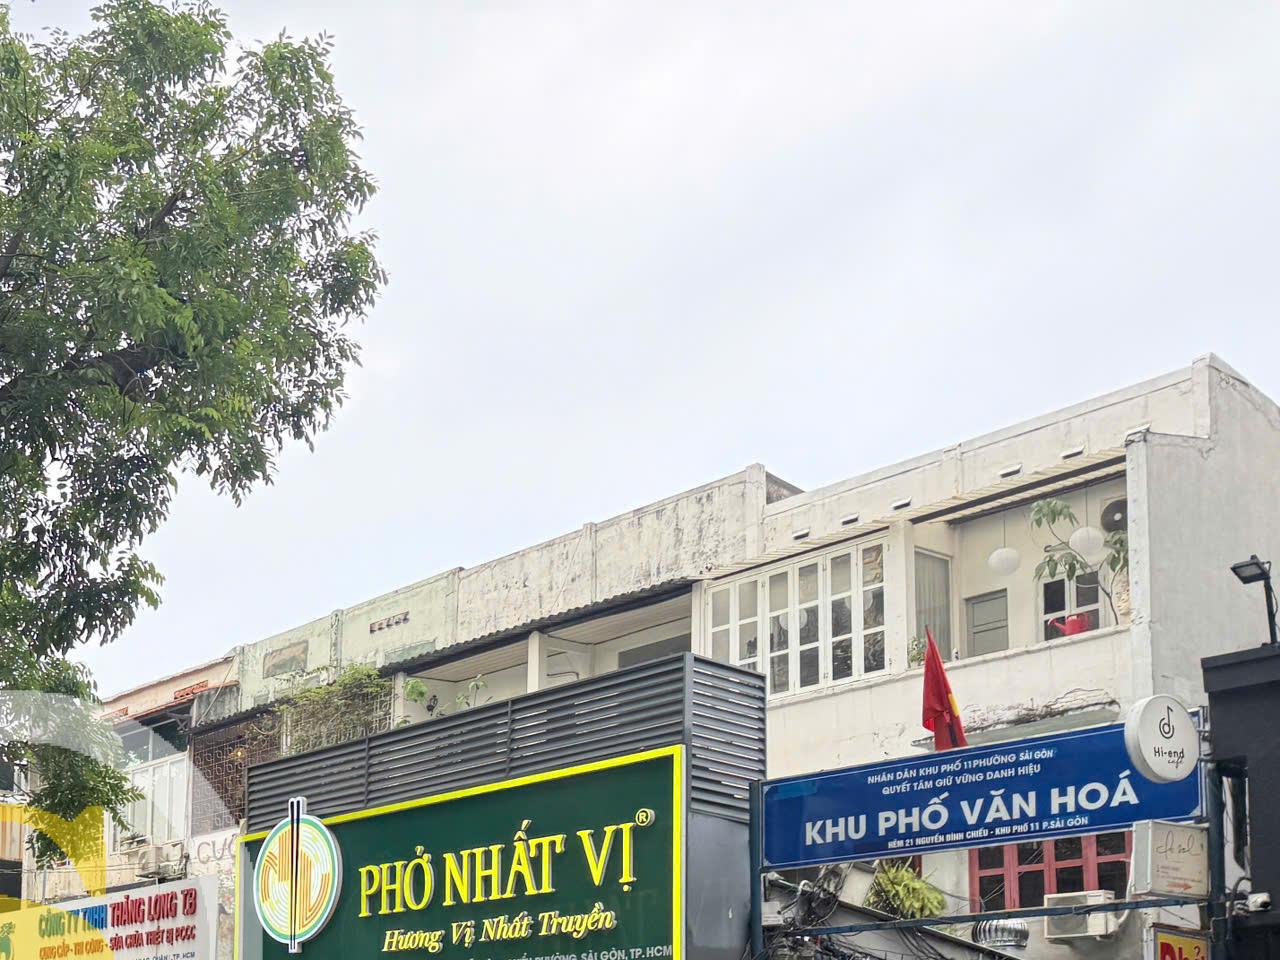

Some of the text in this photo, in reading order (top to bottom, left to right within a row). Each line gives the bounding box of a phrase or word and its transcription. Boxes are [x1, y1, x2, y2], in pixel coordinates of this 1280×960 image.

[919, 765, 939, 776] KHU
[941, 757, 962, 773] PHỐ
[1153, 746, 1185, 758] Hi-end
[986, 767, 1015, 780] DANH
[1018, 763, 1041, 777] HIỆU
[805, 769, 1140, 846] KHU PHỐ VĂN HOÁ
[905, 838, 914, 848] 21
[995, 826, 1012, 836] KHU
[1030, 822, 1040, 832] 11
[358, 845, 435, 918] PHỞ
[442, 819, 567, 907] NHẤT
[576, 822, 637, 893] VỊ
[39, 908, 66, 938] CÔNG
[66, 909, 80, 934] TY
[81, 904, 108, 932] TNHH
[147, 891, 178, 922] LONG
[382, 901, 617, 953] Hương Vị Nhất Truyền
